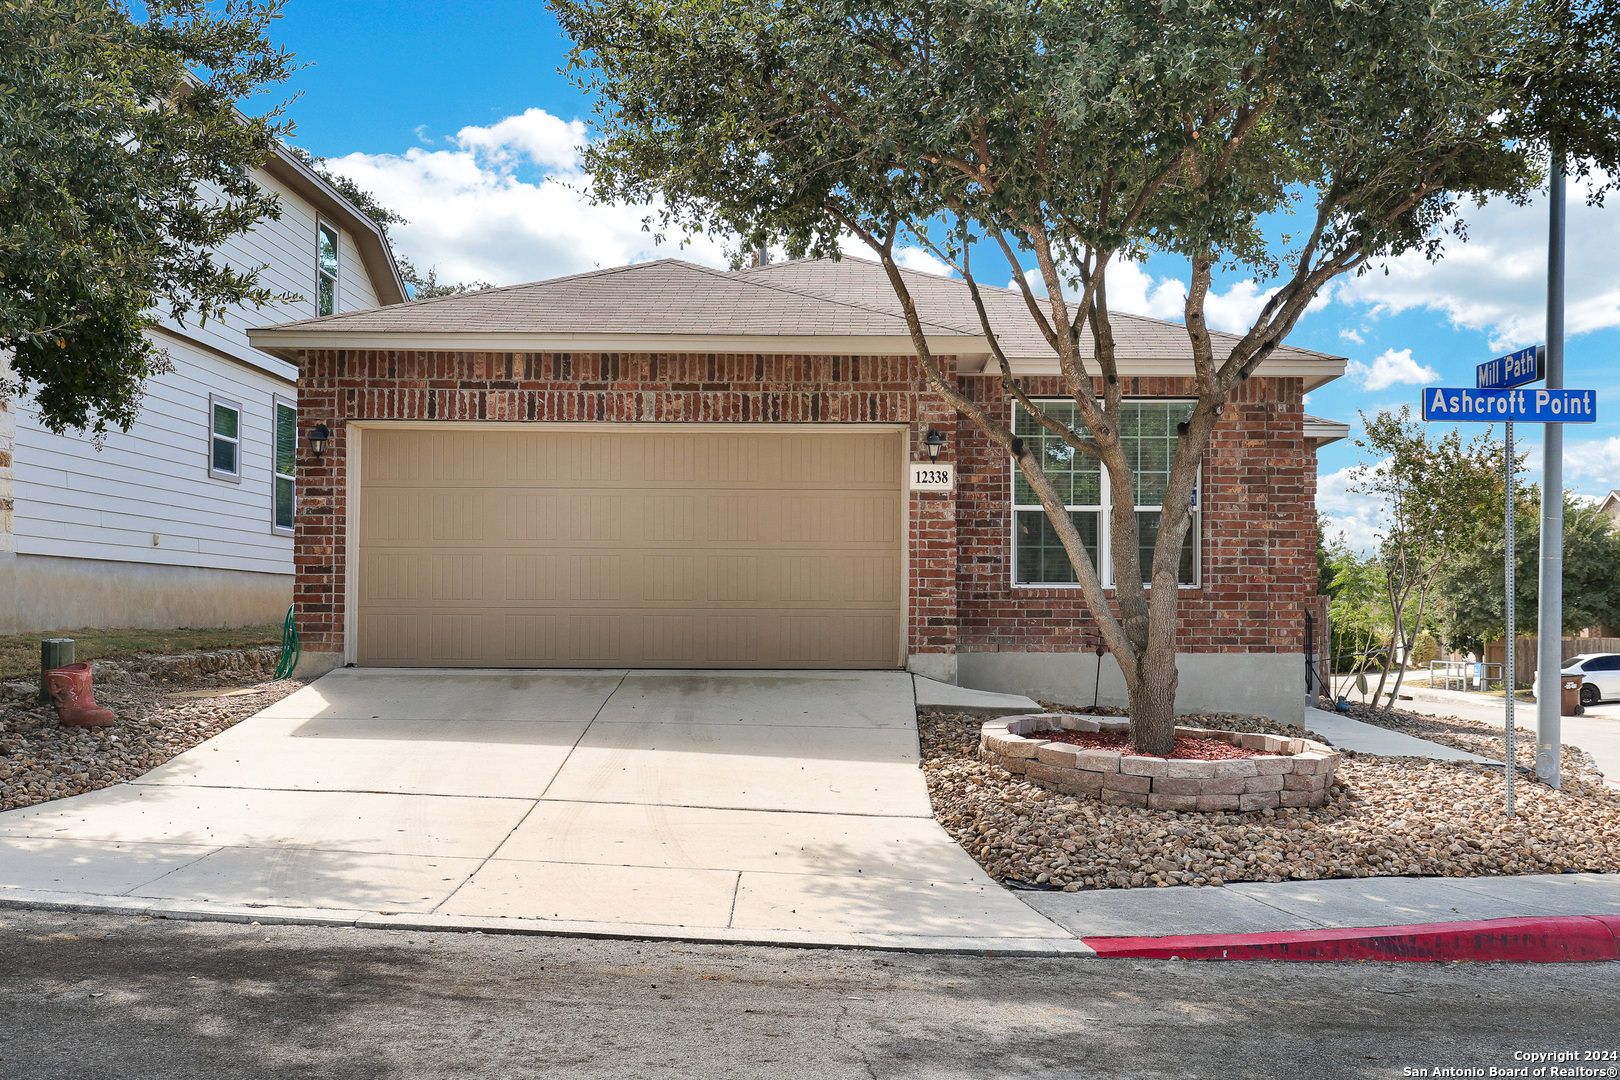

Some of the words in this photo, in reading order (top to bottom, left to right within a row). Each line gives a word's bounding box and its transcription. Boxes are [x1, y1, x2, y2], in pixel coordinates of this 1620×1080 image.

[1478, 361, 1499, 388] Mill
[1505, 350, 1534, 381] Path
[1431, 389, 1526, 414] Ashcroft
[1535, 391, 1591, 415] Point
[916, 470, 948, 484] 12338
